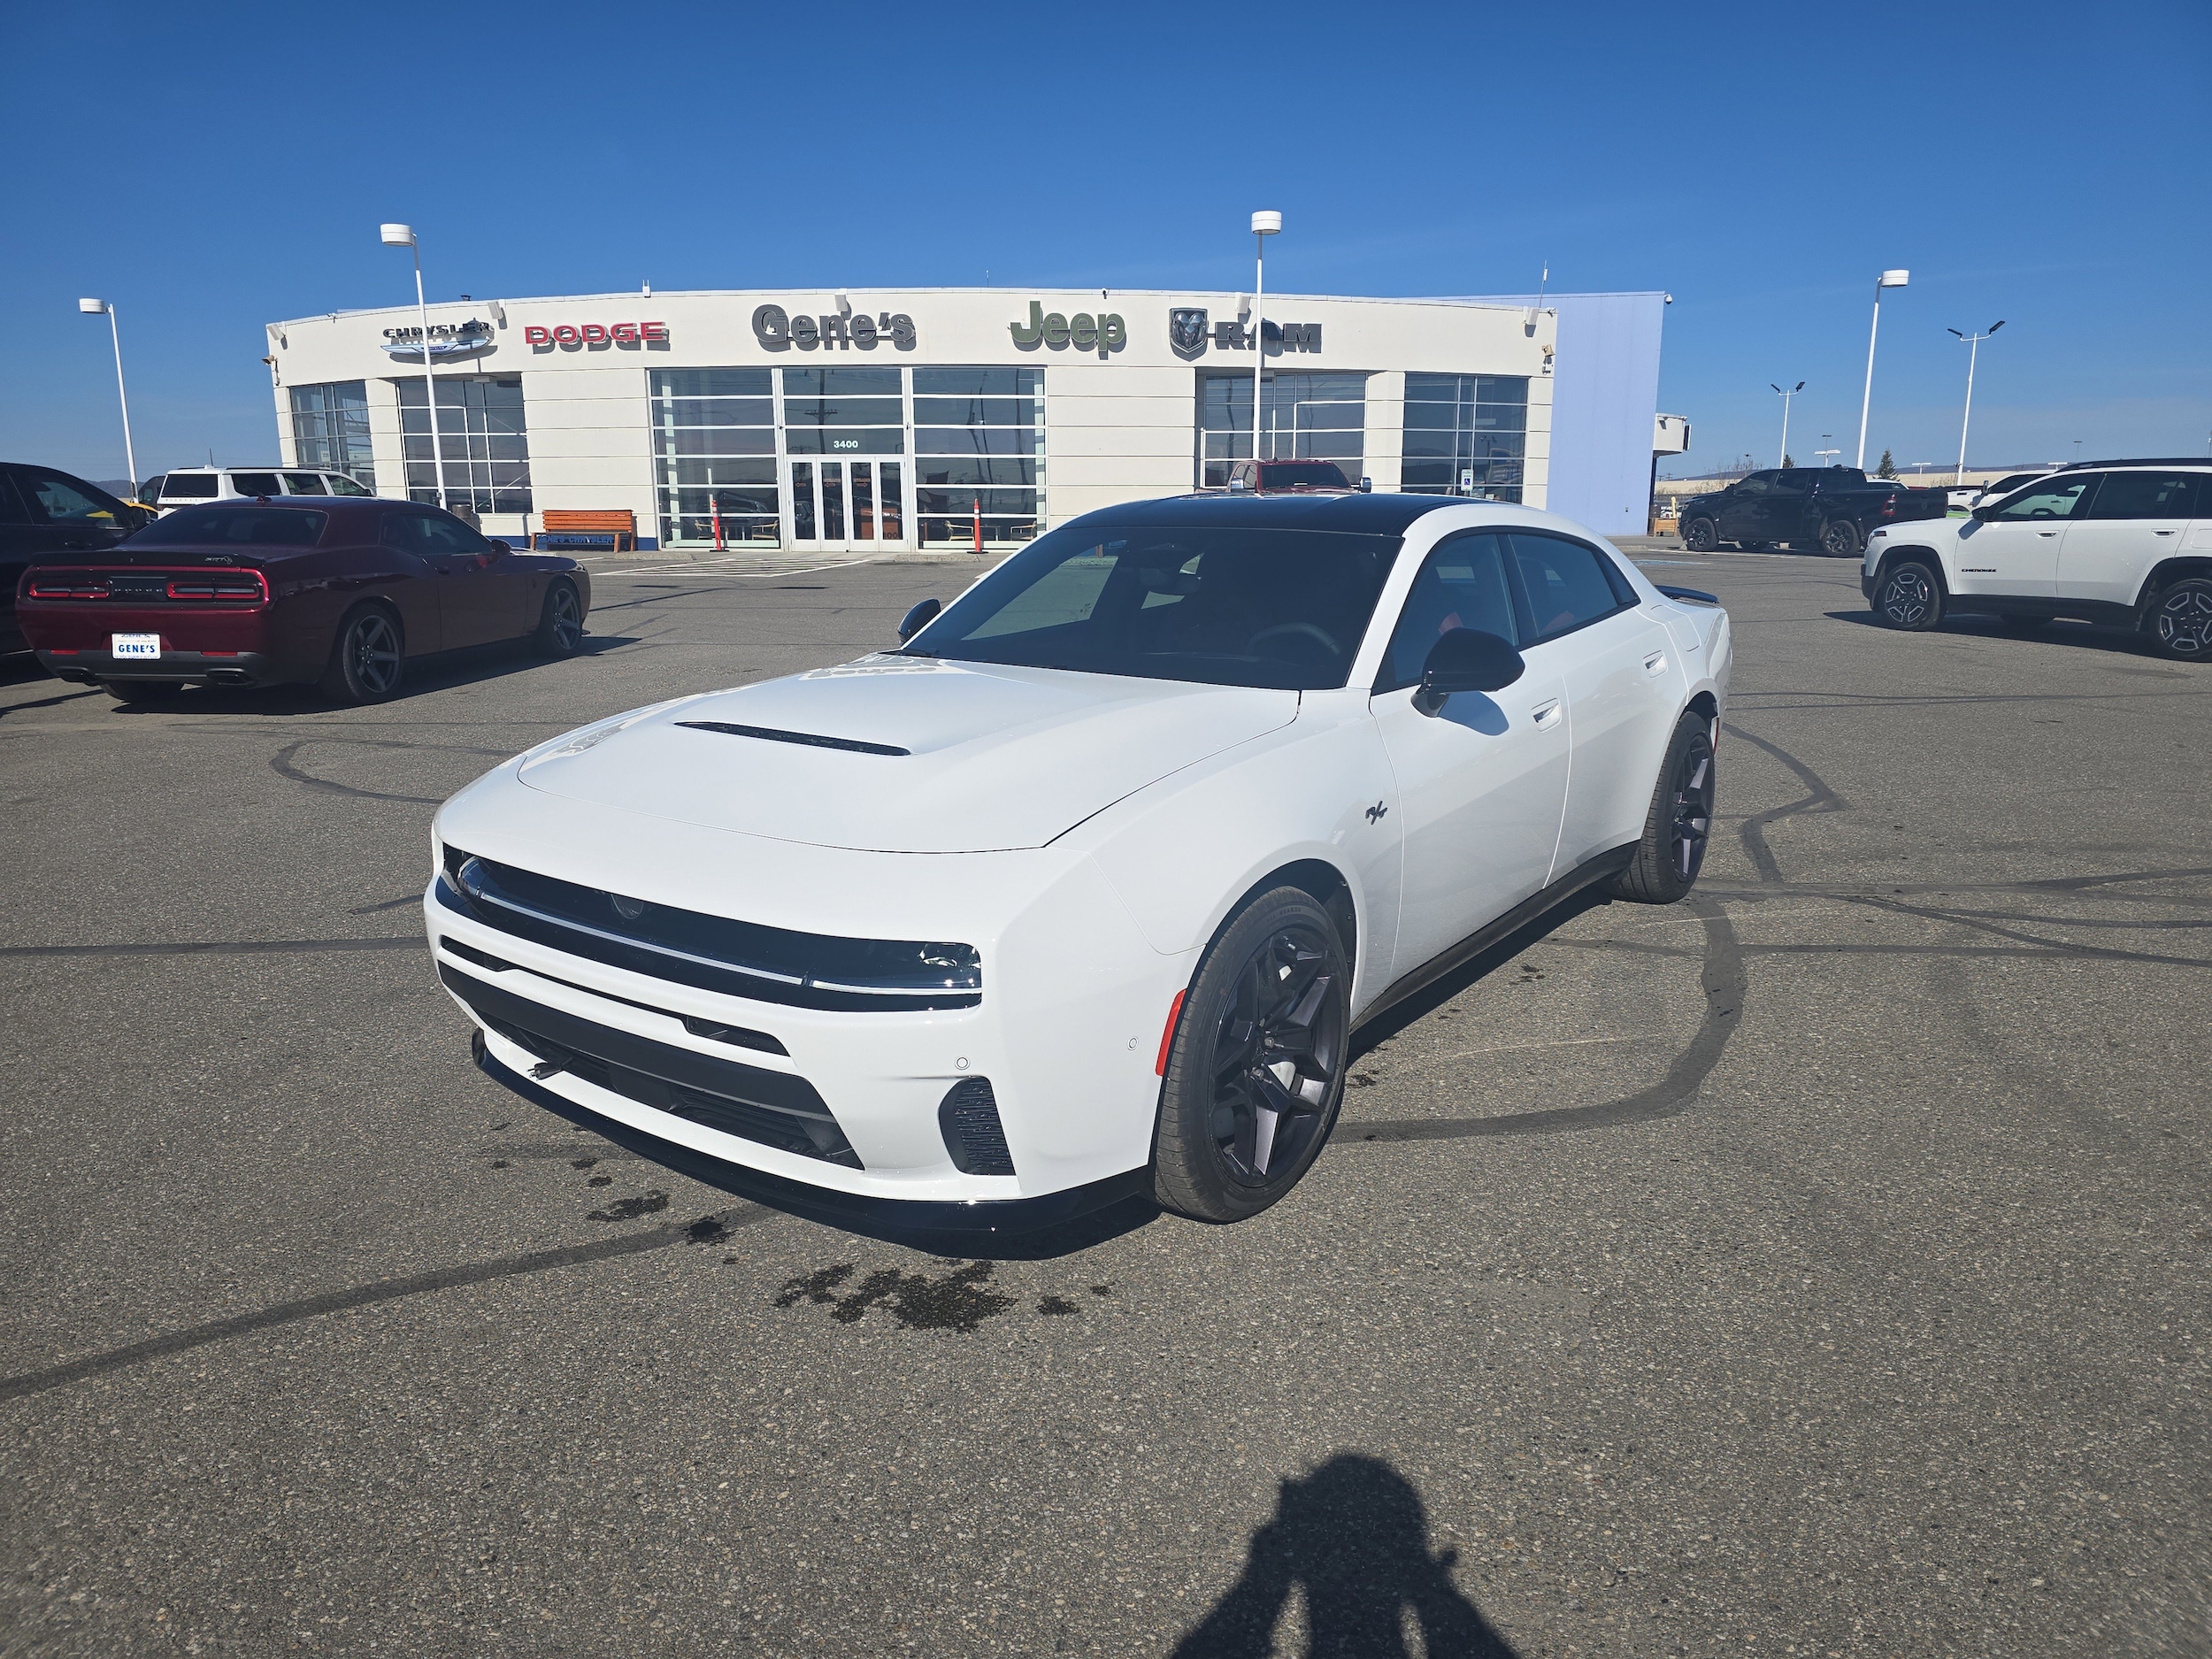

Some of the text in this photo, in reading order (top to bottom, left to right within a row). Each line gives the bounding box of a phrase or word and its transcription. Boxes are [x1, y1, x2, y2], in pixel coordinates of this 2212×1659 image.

[382, 322, 491, 338] CHRYSLER
[525, 322, 668, 344] DODGE
[752, 304, 914, 342] Gene's
[1010, 301, 1125, 351] Jeep
[1215, 321, 1322, 343] RAM
[833, 440, 859, 449] 3400
[119, 644, 155, 653] GENE'S
